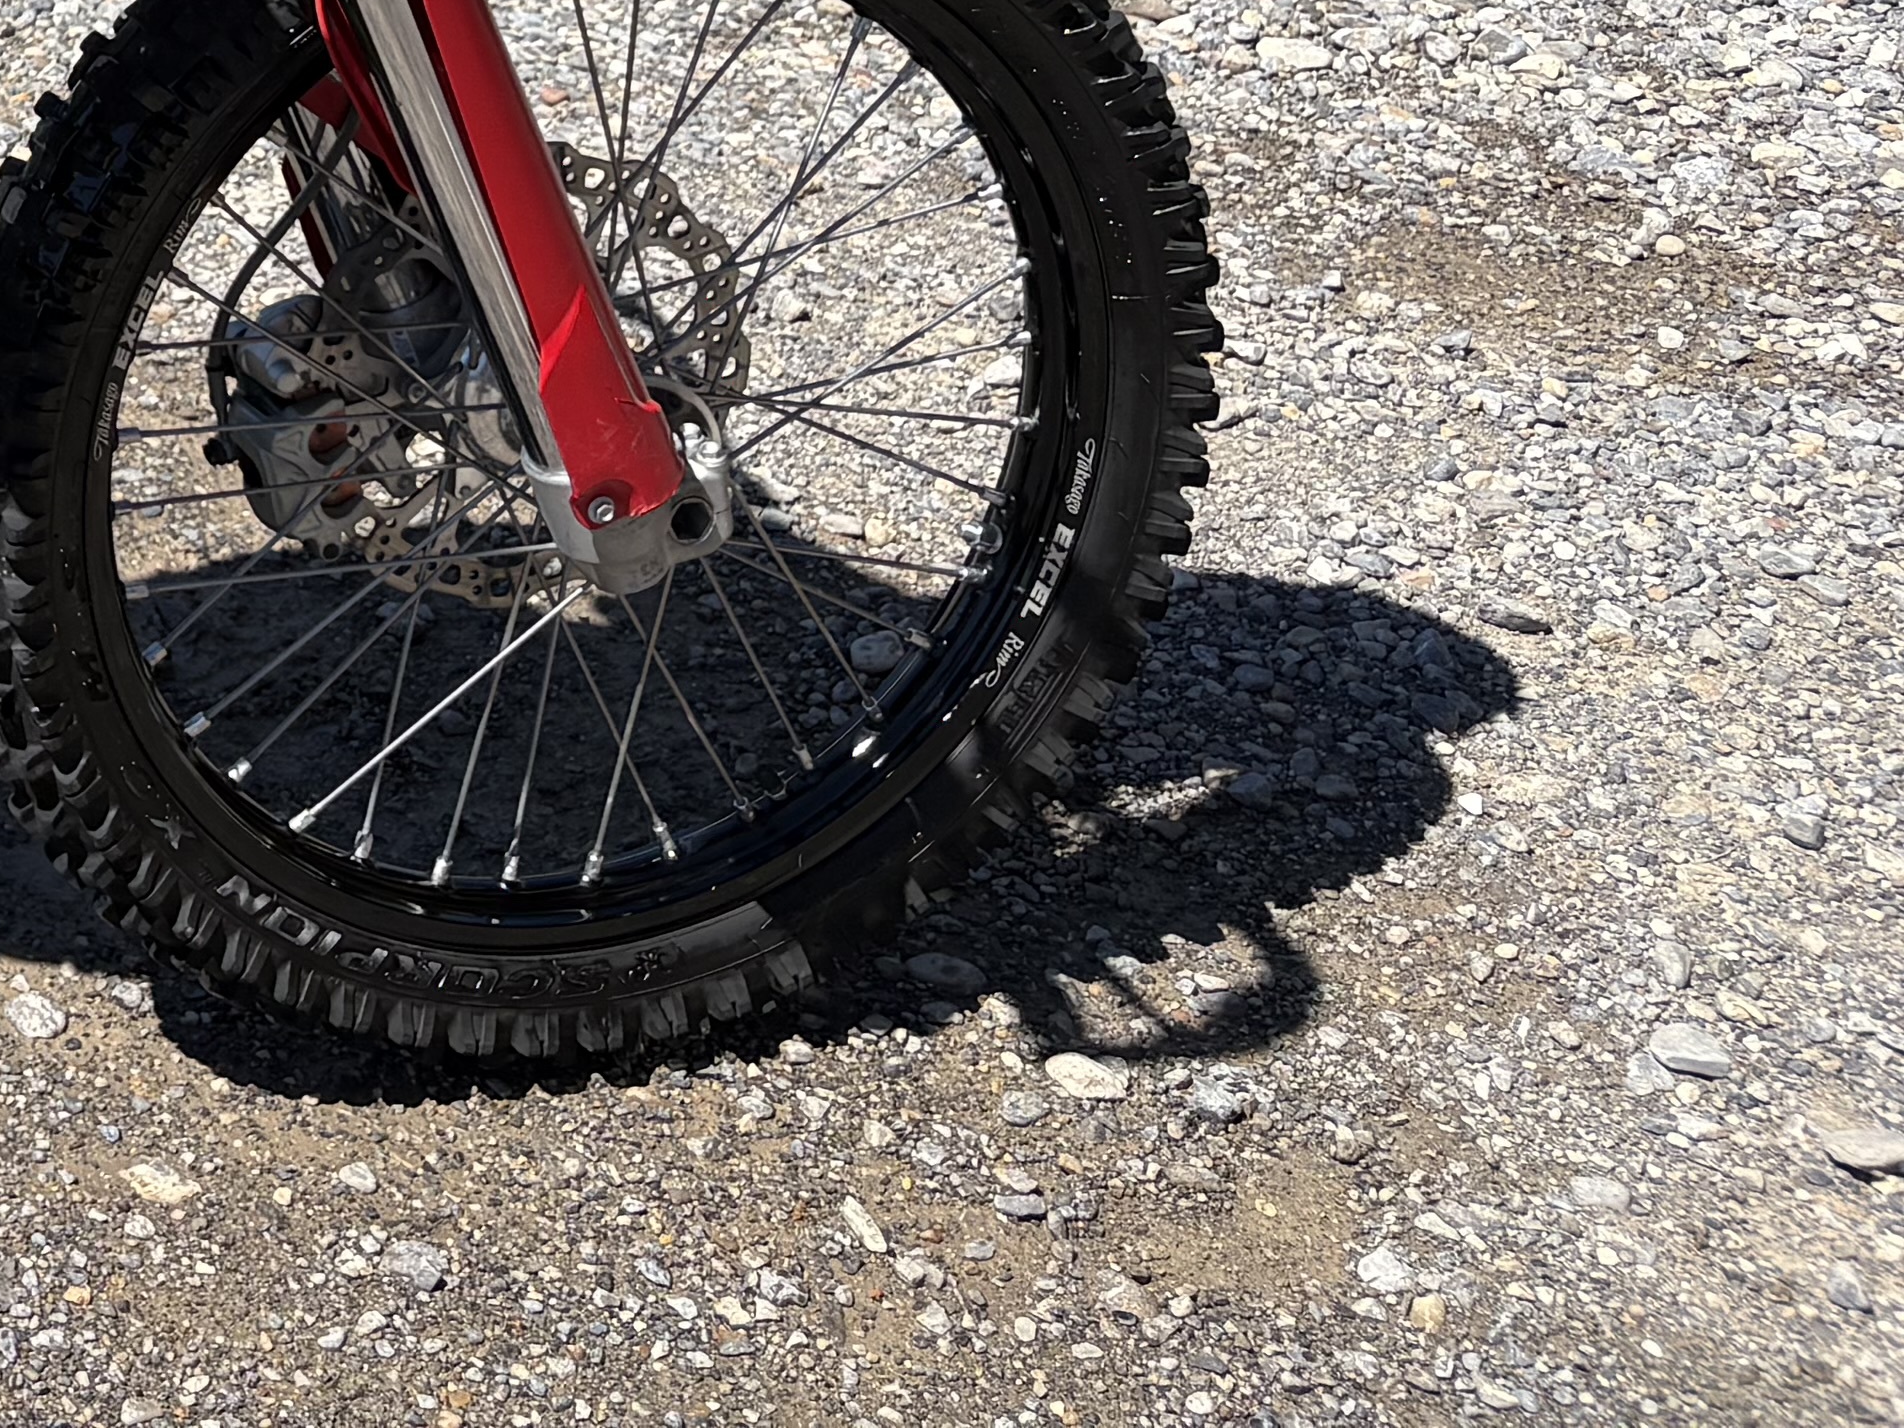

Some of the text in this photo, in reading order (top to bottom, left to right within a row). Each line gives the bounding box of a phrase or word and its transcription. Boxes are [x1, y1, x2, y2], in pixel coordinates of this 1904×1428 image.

[93, 382, 118, 461] Takasago
[112, 270, 165, 371] EXCEL
[985, 438, 1096, 688] Takasago EXCEL Rim
[214, 873, 611, 1001] SCORPION
